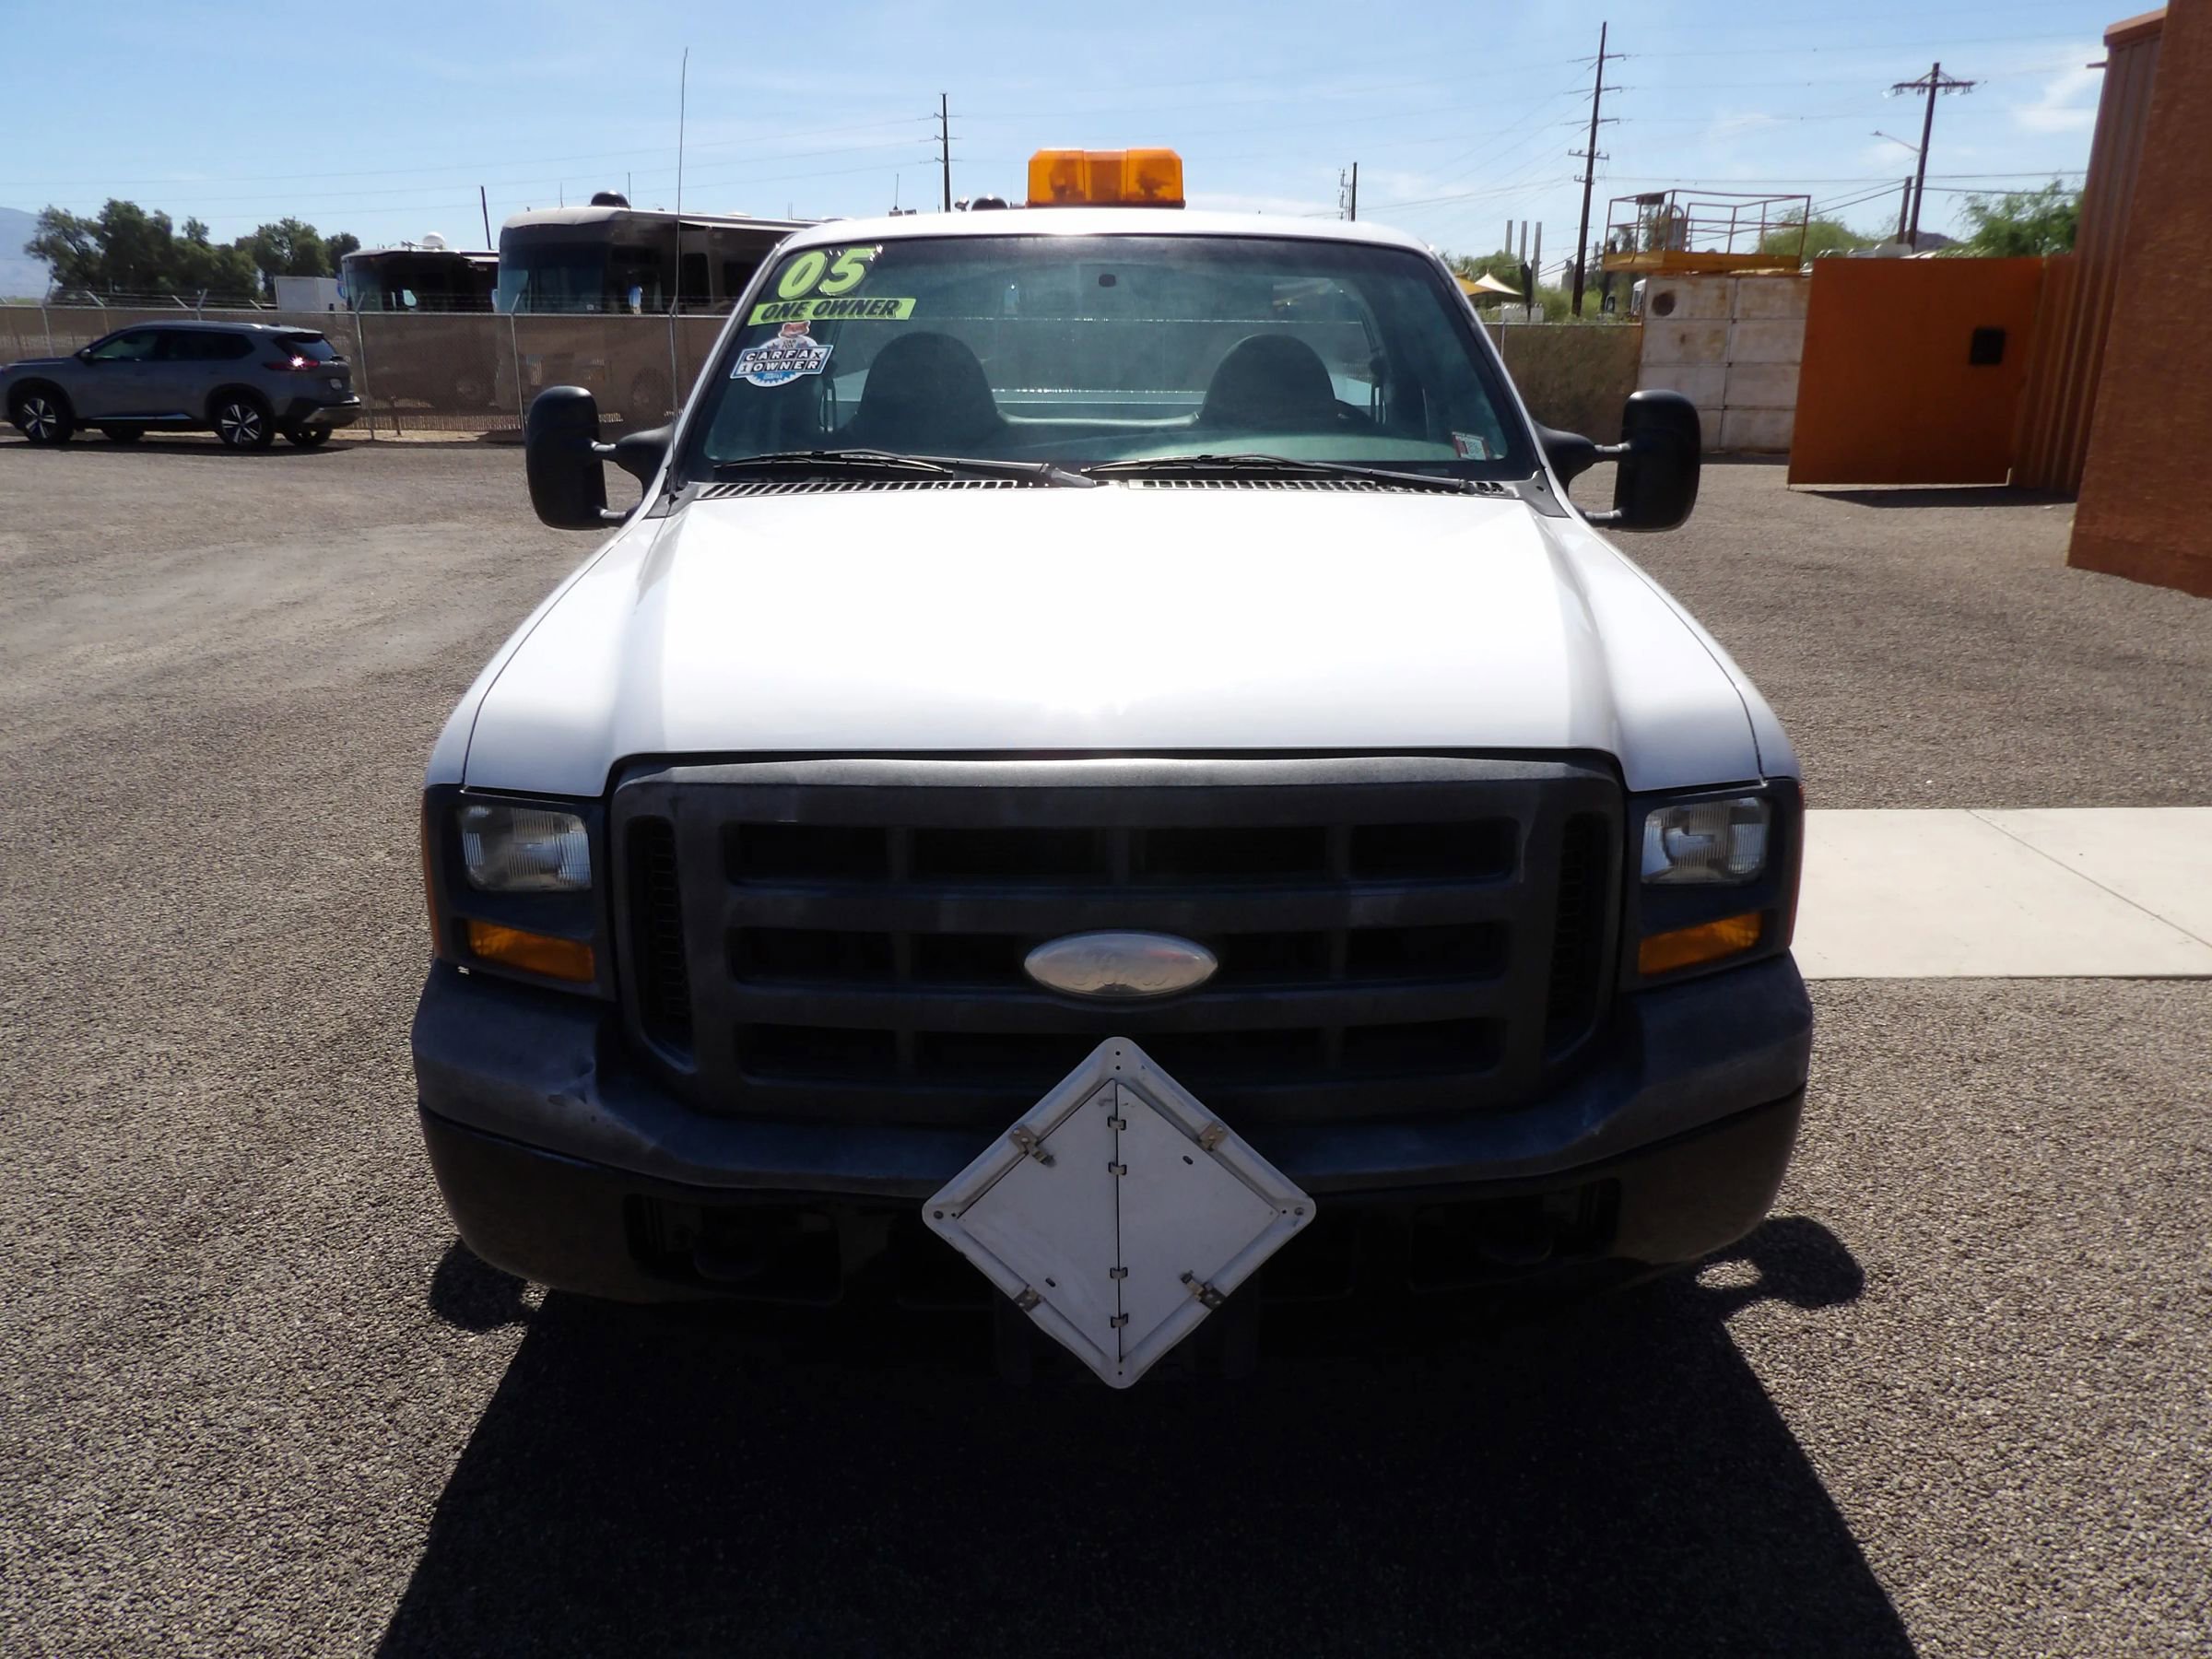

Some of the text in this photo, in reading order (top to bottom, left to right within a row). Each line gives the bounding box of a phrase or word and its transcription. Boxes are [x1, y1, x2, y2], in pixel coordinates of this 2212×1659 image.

[777, 247, 877, 300] 05
[760, 299, 902, 322] ONE OWNER
[745, 349, 823, 361] CARFAX
[752, 360, 819, 371] OWNER
